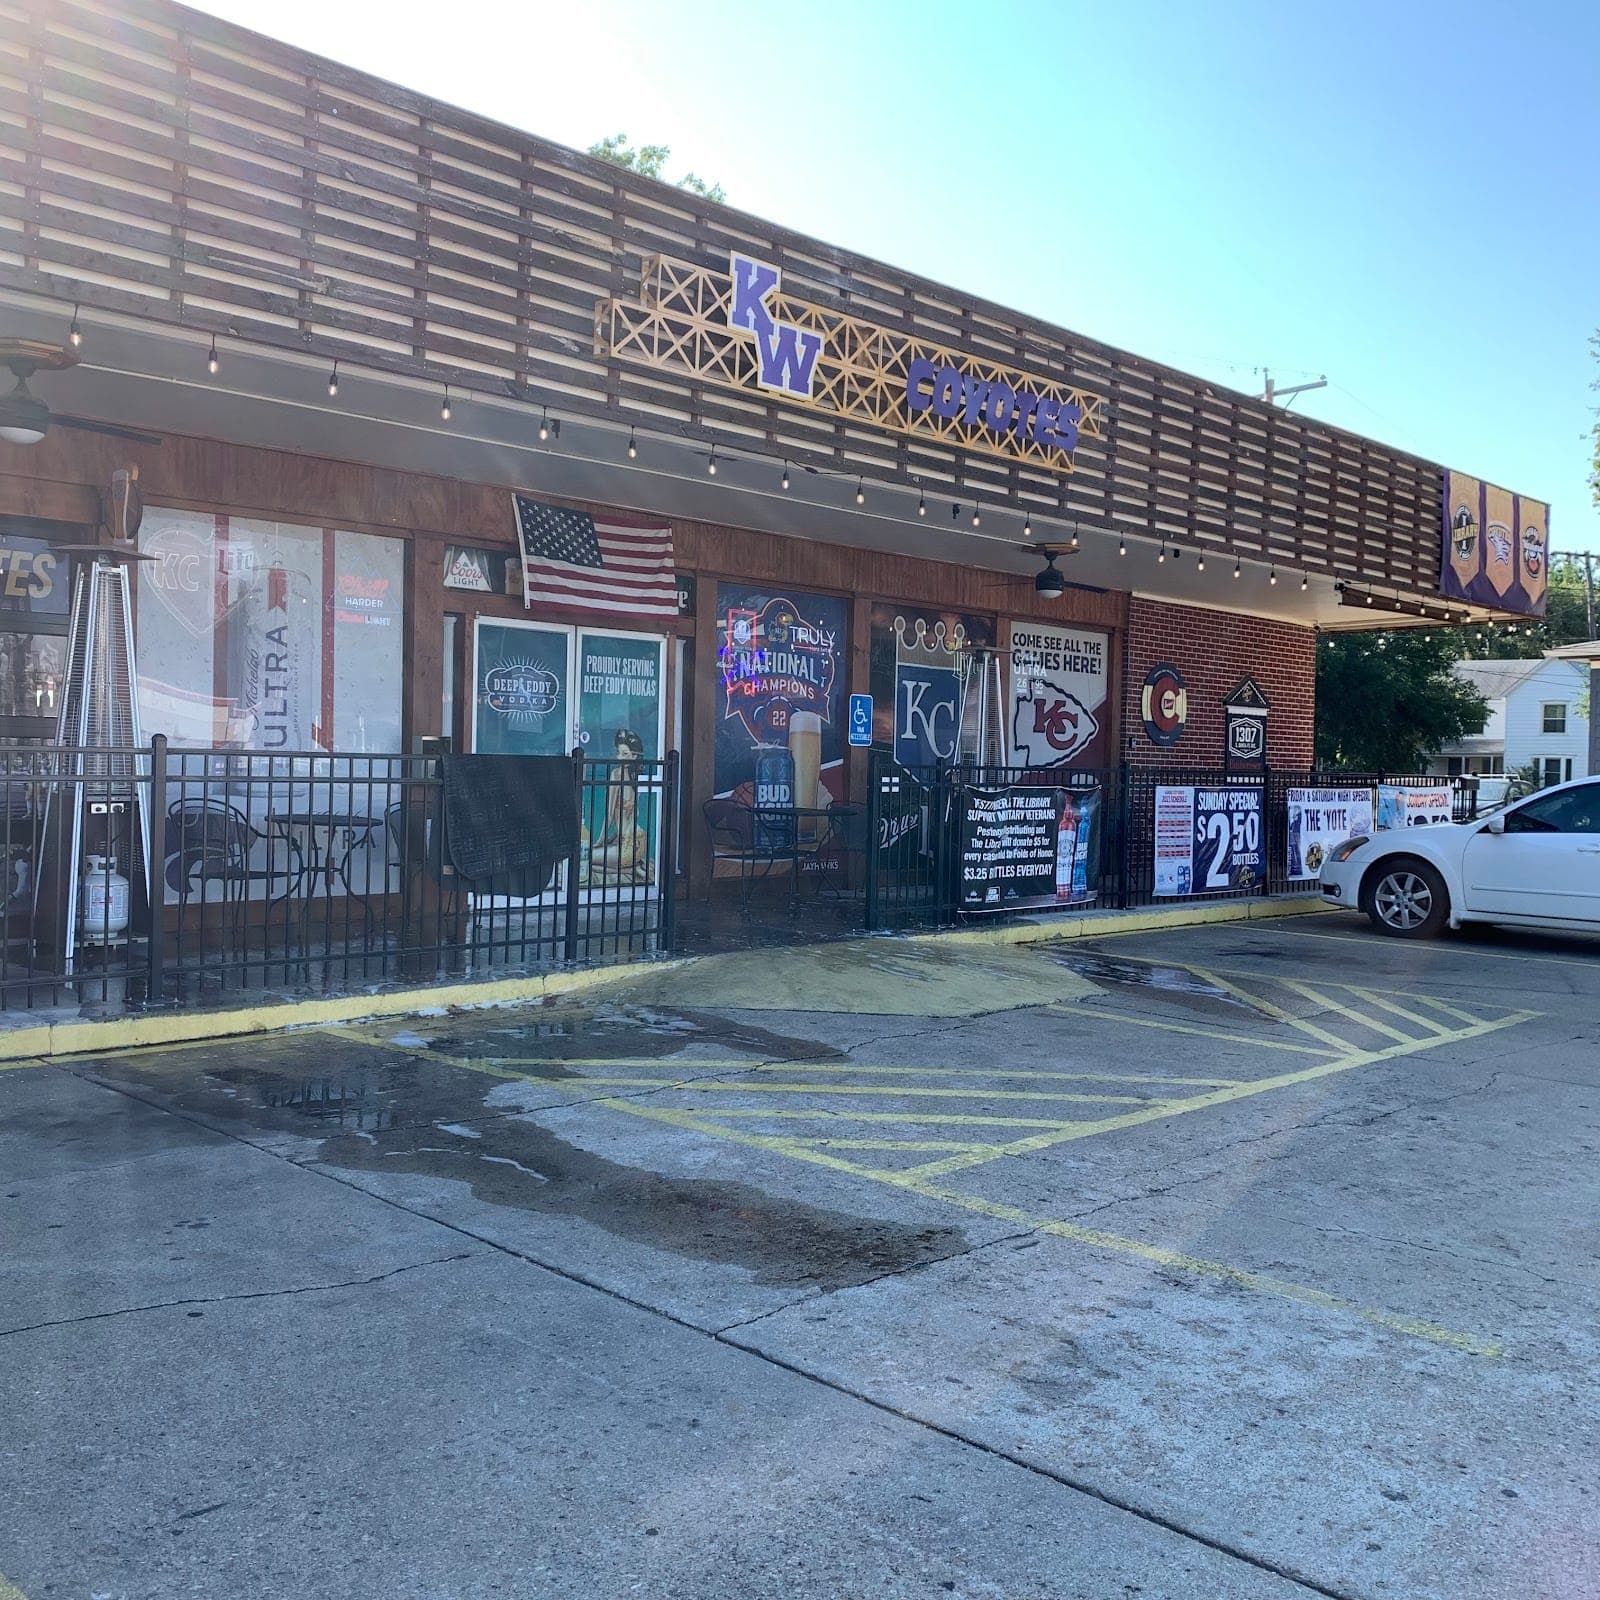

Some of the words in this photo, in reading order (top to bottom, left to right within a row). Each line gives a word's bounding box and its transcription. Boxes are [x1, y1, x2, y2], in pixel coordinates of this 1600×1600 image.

[906, 358, 1082, 450] COYOTES
[451, 561, 483, 579] Coors
[453, 577, 479, 587] LIGHT
[345, 596, 384, 609] HARDER
[789, 626, 835, 647] TRULY
[1012, 632, 1042, 649] COME
[1044, 636, 1062, 651] SEE
[1063, 639, 1081, 653] ALL
[1083, 641, 1101, 655] THE
[586, 655, 623, 676] PROUDLY
[623, 657, 654, 677] SERVING
[739, 651, 819, 685] NATIONAL
[1012, 649, 1060, 671] GAMES
[1063, 654, 1101, 675] HERE!
[1014, 662, 1048, 677] ULTRA
[264, 625, 288, 748] ULTRA
[493, 678, 518, 692] DEEP
[526, 680, 552, 694] EDDY
[584, 675, 603, 693] DEEP
[605, 676, 625, 695] EDDY
[626, 679, 656, 697] VODKAS
[744, 678, 815, 700] CHAMPIONS
[499, 695, 548, 705] VODKA
[772, 710, 786, 726] 22
[901, 680, 955, 759] KC
[1033, 698, 1078, 750] KC
[1235, 726, 1257, 743] 1307
[757, 784, 790, 802] BUD
[1198, 792, 1229, 811] SUNDAY
[1229, 791, 1260, 811] SPECIAL
[1288, 789, 1306, 802] FRIDAY
[1311, 789, 1337, 802] SATURDAY
[1352, 789, 1371, 802] SPECIAL
[1025, 796, 1051, 808] LIBRARY
[1025, 808, 1056, 820] VETERANS
[1304, 808, 1321, 832] THE
[1035, 824, 1046, 834] and
[971, 838, 983, 848] The
[1012, 836, 1033, 847] donate
[1033, 836, 1042, 847] $5
[1042, 836, 1050, 846] for
[964, 852, 982, 863] every
[1029, 848, 1037, 859] of
[1232, 853, 1259, 866] BOTTLES
[964, 866, 988, 881] $3.25
[1016, 864, 1053, 877] EVERYDAY
